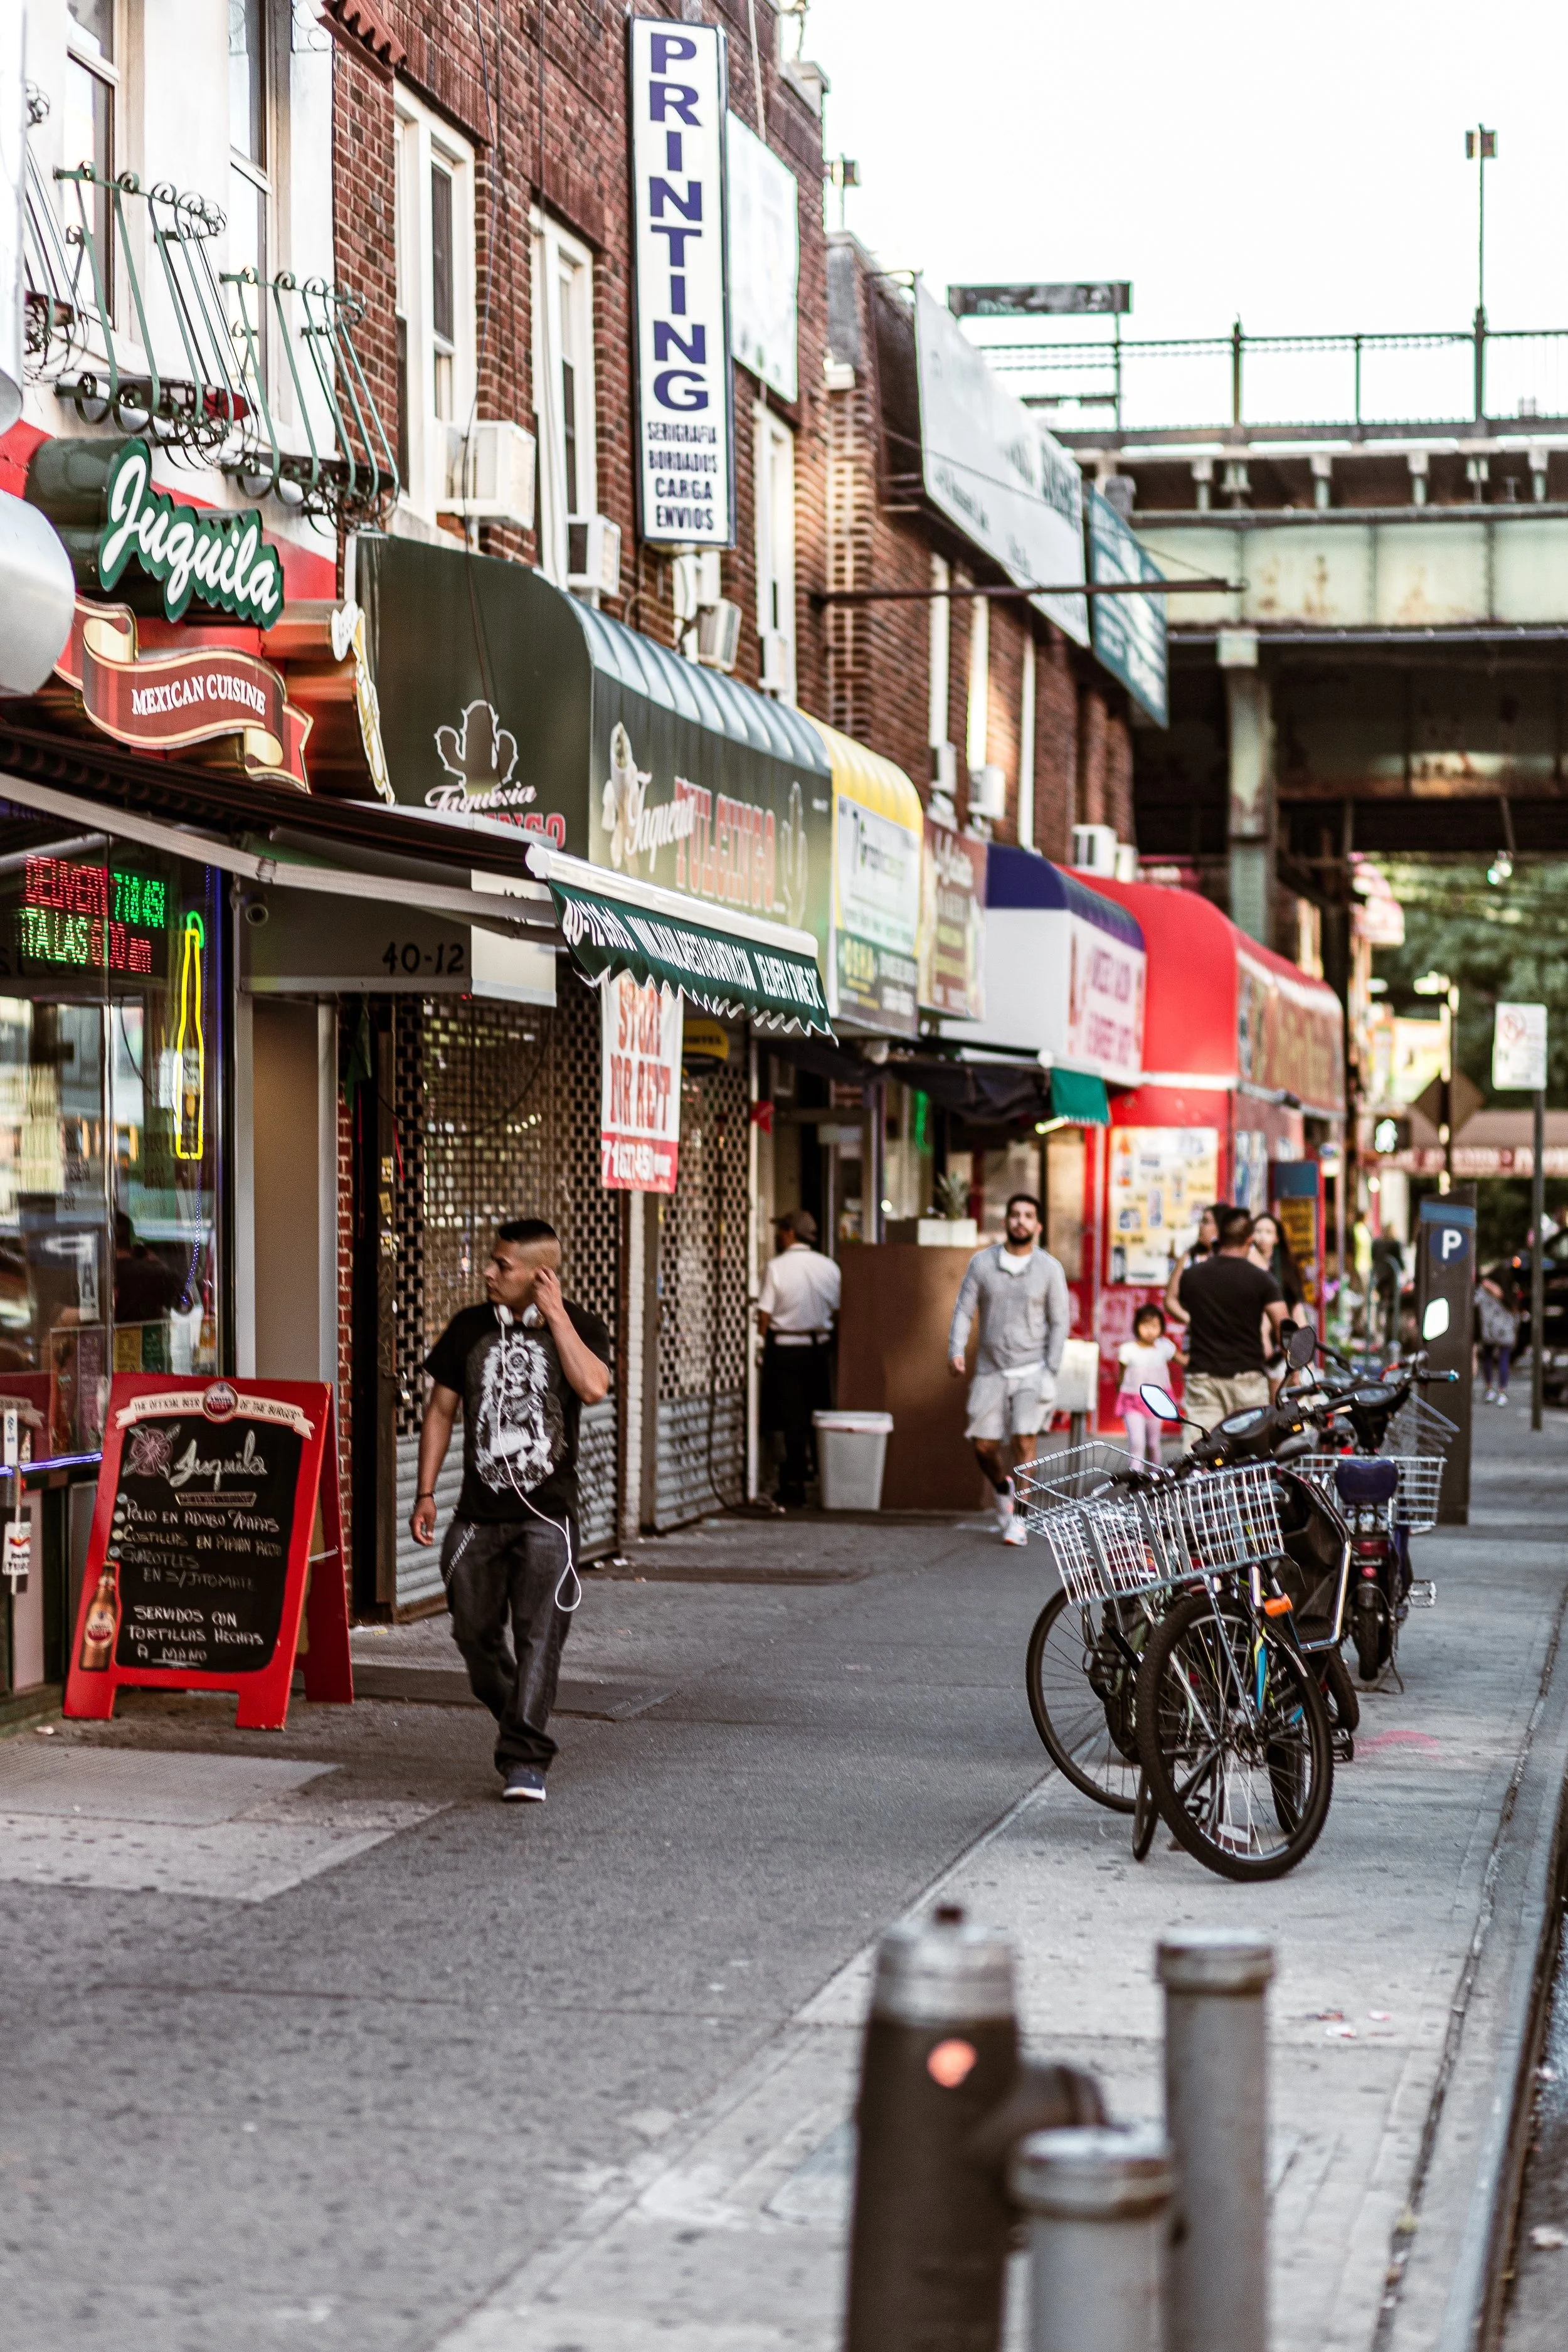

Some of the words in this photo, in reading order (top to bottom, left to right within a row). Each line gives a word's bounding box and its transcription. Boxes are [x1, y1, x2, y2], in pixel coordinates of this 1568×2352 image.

[649, 31, 709, 412] PRINTING
[649, 450, 717, 474] BORDADOS
[655, 477, 712, 499] CARGA
[656, 504, 714, 531] ENVIOS
[102, 454, 278, 614] Juquila
[131, 675, 204, 716] MEXICAN
[206, 673, 267, 716] CUISINE
[383, 941, 464, 974] 40-12
[169, 1428, 268, 1493] Juquila
[162, 1510, 179, 1524] EN
[184, 1510, 226, 1528] ADOBO
[196, 1534, 212, 1550] EN
[143, 1567, 161, 1582] EN
[133, 1604, 204, 1624] SERVIDOS
[211, 1610, 237, 1628] CON
[125, 1624, 206, 1642] TORTILLAS
[214, 1627, 263, 1646] HECHAS
[137, 1642, 149, 1659] A
[162, 1645, 208, 1662] MANO
